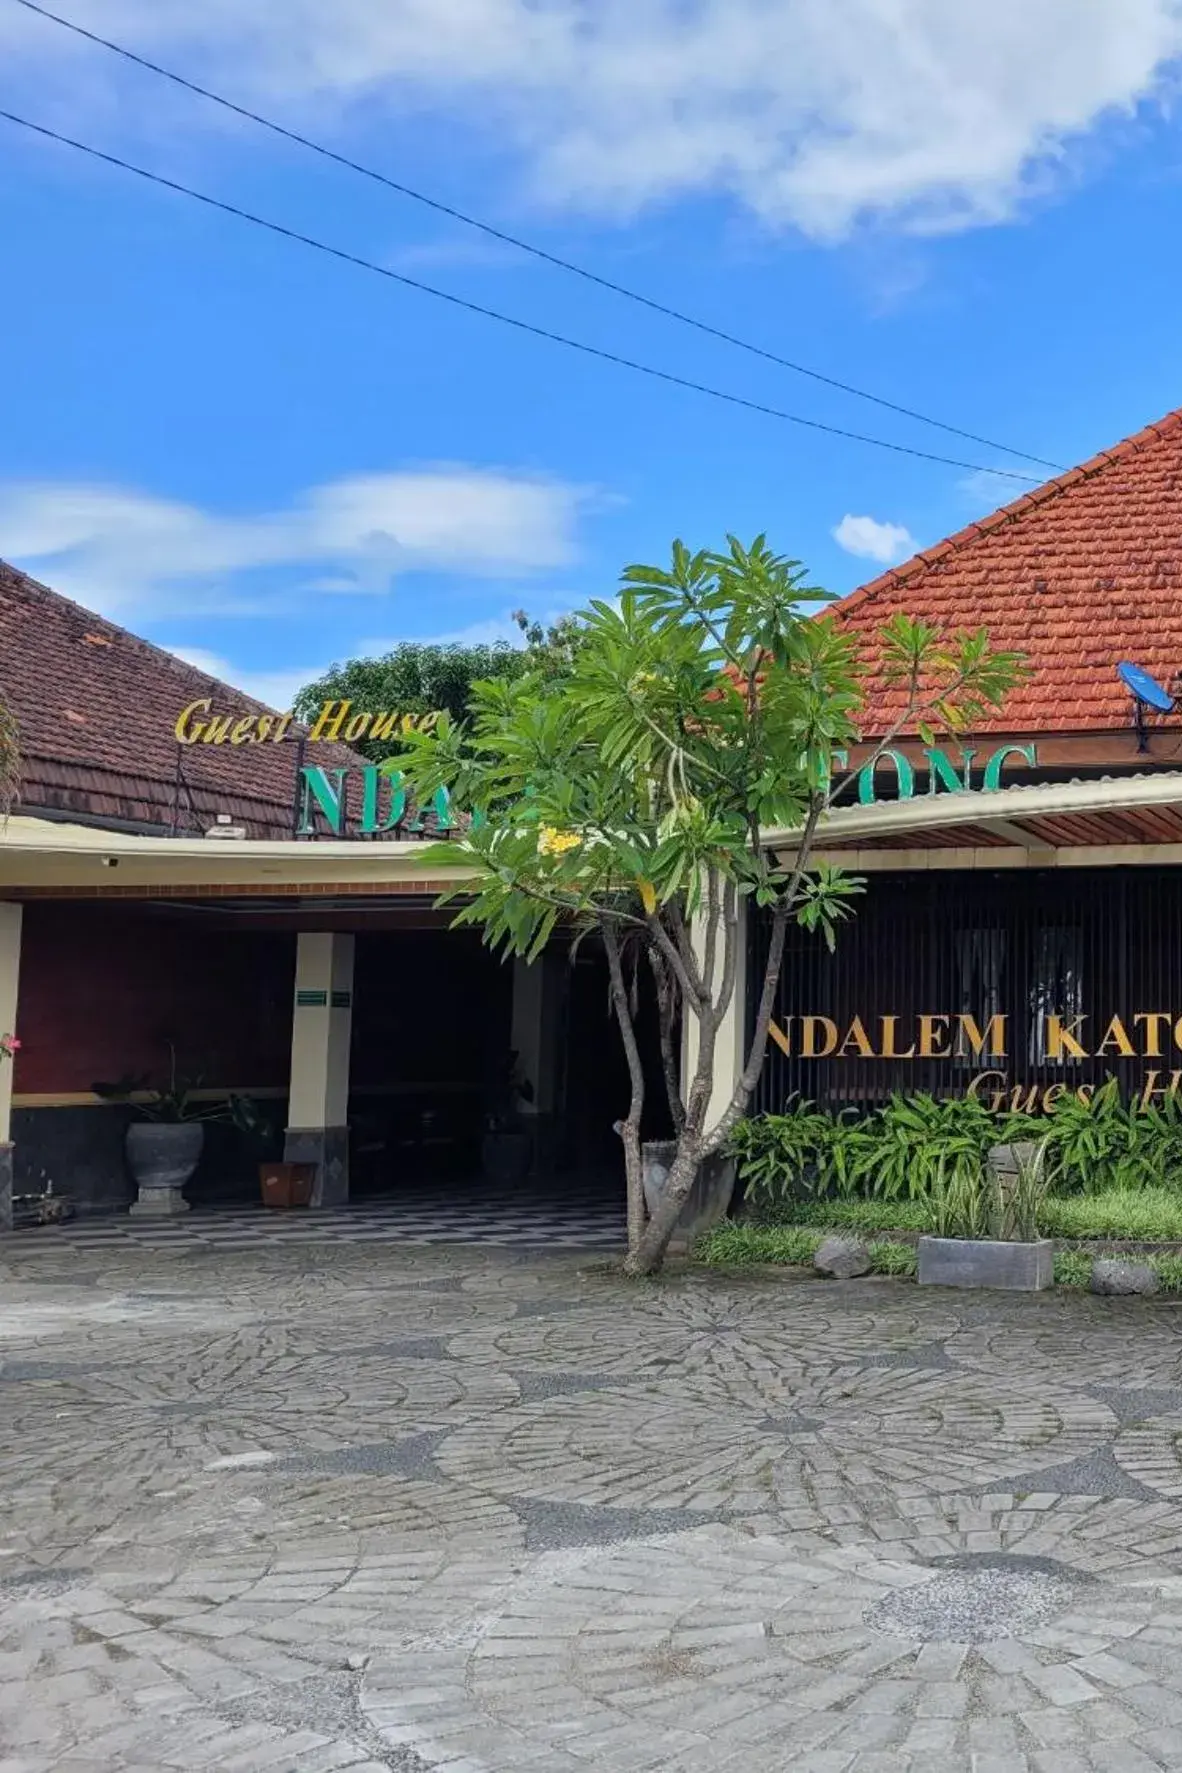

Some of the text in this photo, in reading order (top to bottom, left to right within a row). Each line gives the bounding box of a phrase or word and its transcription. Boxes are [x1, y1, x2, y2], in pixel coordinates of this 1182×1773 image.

[174, 699, 441, 746] Guest House
[756, 1013, 1009, 1058] NDALEM
[967, 1069, 1110, 1116] Gues
